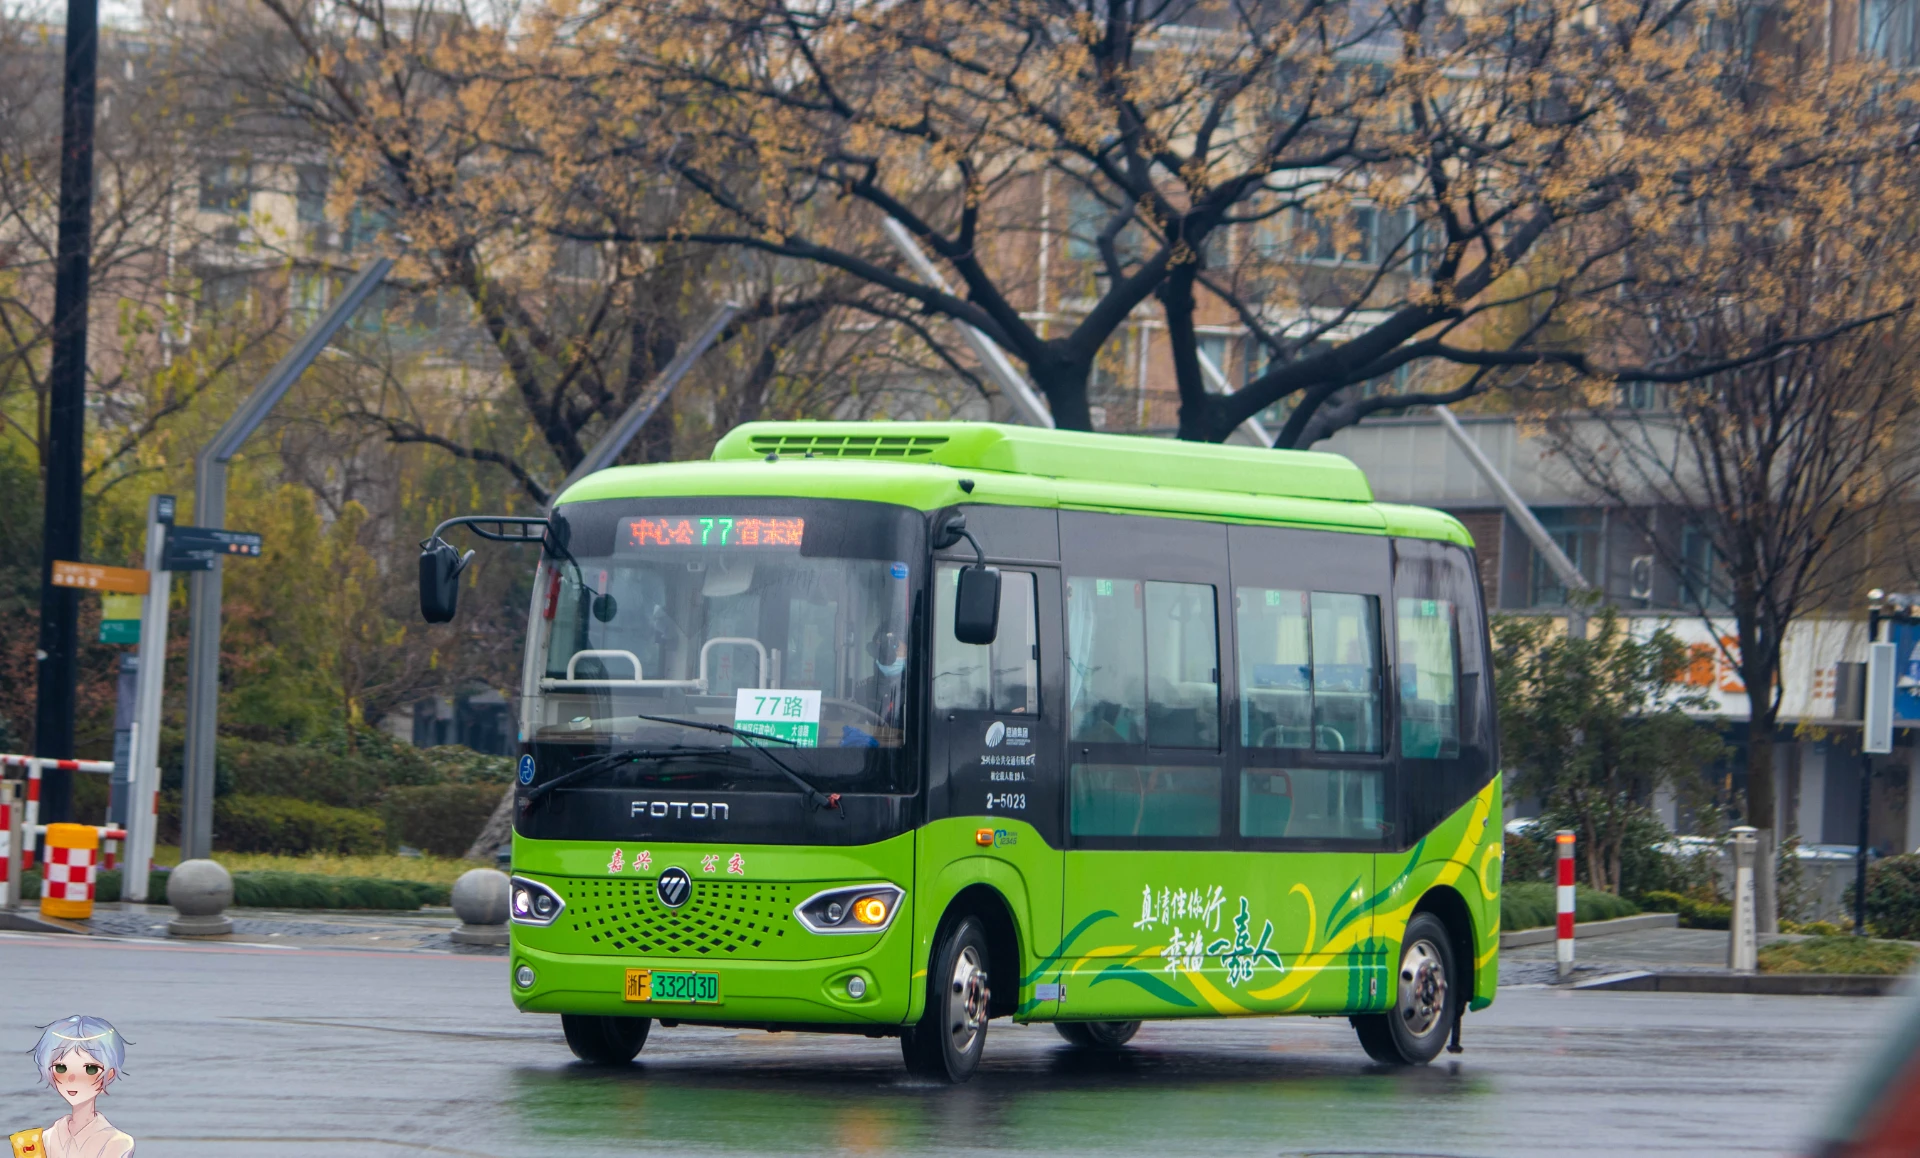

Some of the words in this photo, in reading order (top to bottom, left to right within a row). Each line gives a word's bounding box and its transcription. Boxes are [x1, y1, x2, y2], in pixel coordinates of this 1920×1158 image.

[698, 517, 734, 547] 77
[754, 695, 803, 718] 77路
[630, 801, 730, 820] FOTON
[986, 792, 1026, 809] 2-5023
[607, 848, 653, 873] 嘉兴
[700, 853, 745, 875] 公交
[627, 974, 648, 997] 浙F
[655, 974, 717, 998] 33203D
